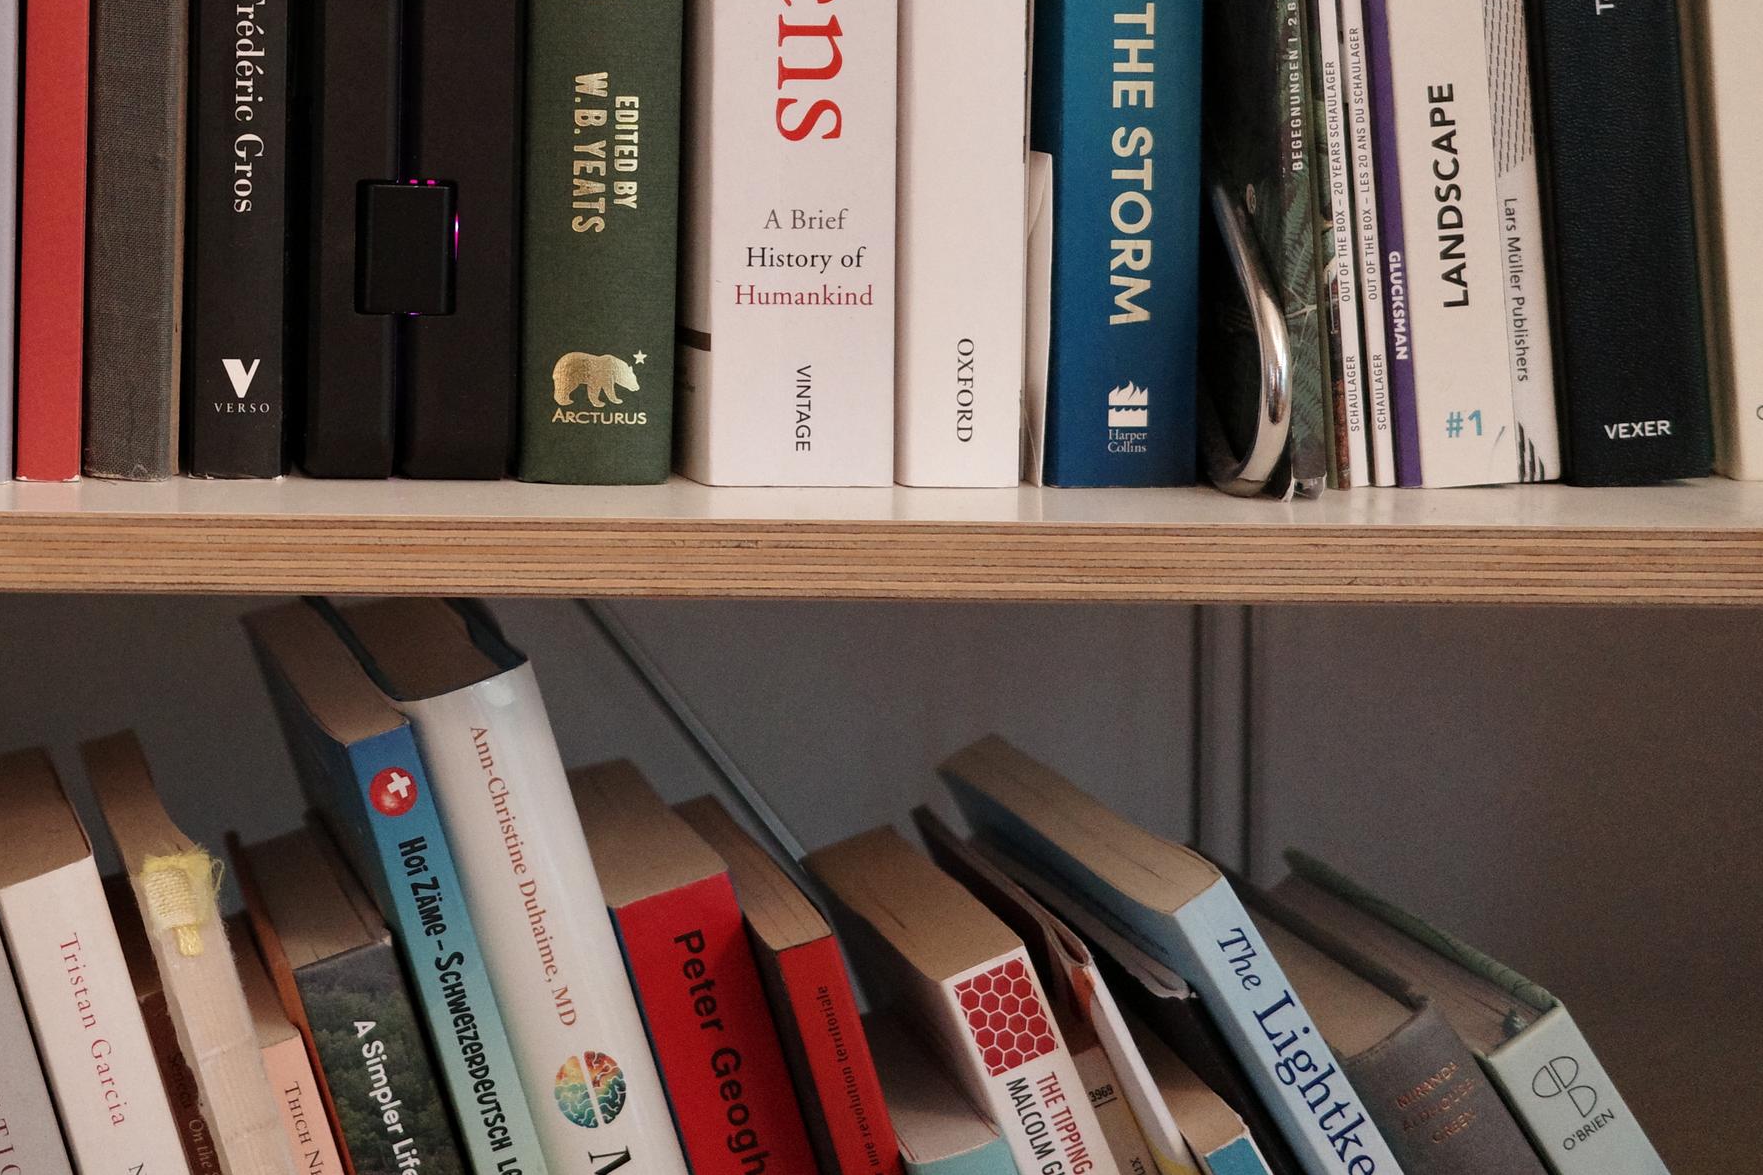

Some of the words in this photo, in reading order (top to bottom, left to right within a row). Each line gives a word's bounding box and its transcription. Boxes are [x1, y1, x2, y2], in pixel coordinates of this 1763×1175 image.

[1111, 3, 1155, 110] THE
[614, 96, 640, 172] EDITED
[1290, 52, 1303, 171] BEGEGNUNGEN
[233, 132, 265, 213] Gros
[571, 139, 607, 233] YEATS
[613, 181, 638, 209] BY
[1427, 82, 1469, 309] LANDSCAPE
[764, 209, 783, 230] A
[791, 208, 848, 231] Brief
[1109, 126, 1153, 326] STORM
[1503, 197, 1518, 232] Lars
[734, 284, 874, 306] Humankind
[746, 246, 833, 274] History
[840, 246, 867, 268] of
[1506, 234, 1523, 292] Müller
[1388, 250, 1409, 361] GLUCKSMAN
[1511, 295, 1529, 383] Publishers
[214, 402, 270, 413] VERSO
[795, 365, 812, 452] VINTAGE
[955, 338, 975, 443] OXFORD
[1346, 355, 1361, 432] SCHAULAGER
[1372, 353, 1387, 431] SCHAULAGER
[1446, 409, 1483, 439] #1
[1107, 441, 1147, 454] Collins
[1108, 430, 1148, 444] Harper
[1604, 420, 1671, 440] VEXER
[470, 727, 525, 873] Ann-Christine
[519, 880, 557, 982] Duhaime,
[552, 986, 575, 1025] MD
[673, 928, 724, 1034] Peter
[1222, 927, 1261, 990] The
[61, 932, 95, 1028] Tristan
[91, 1039, 124, 1124] Garcia
[354, 1021, 375, 1037] A
[362, 1040, 402, 1132] Simpler
[1006, 1077, 1054, 1159] MALCOLM
[1038, 1071, 1065, 1106] THE
[1052, 1106, 1092, 1174] TIPPING
[1563, 1108, 1614, 1150] O'BRIEN
